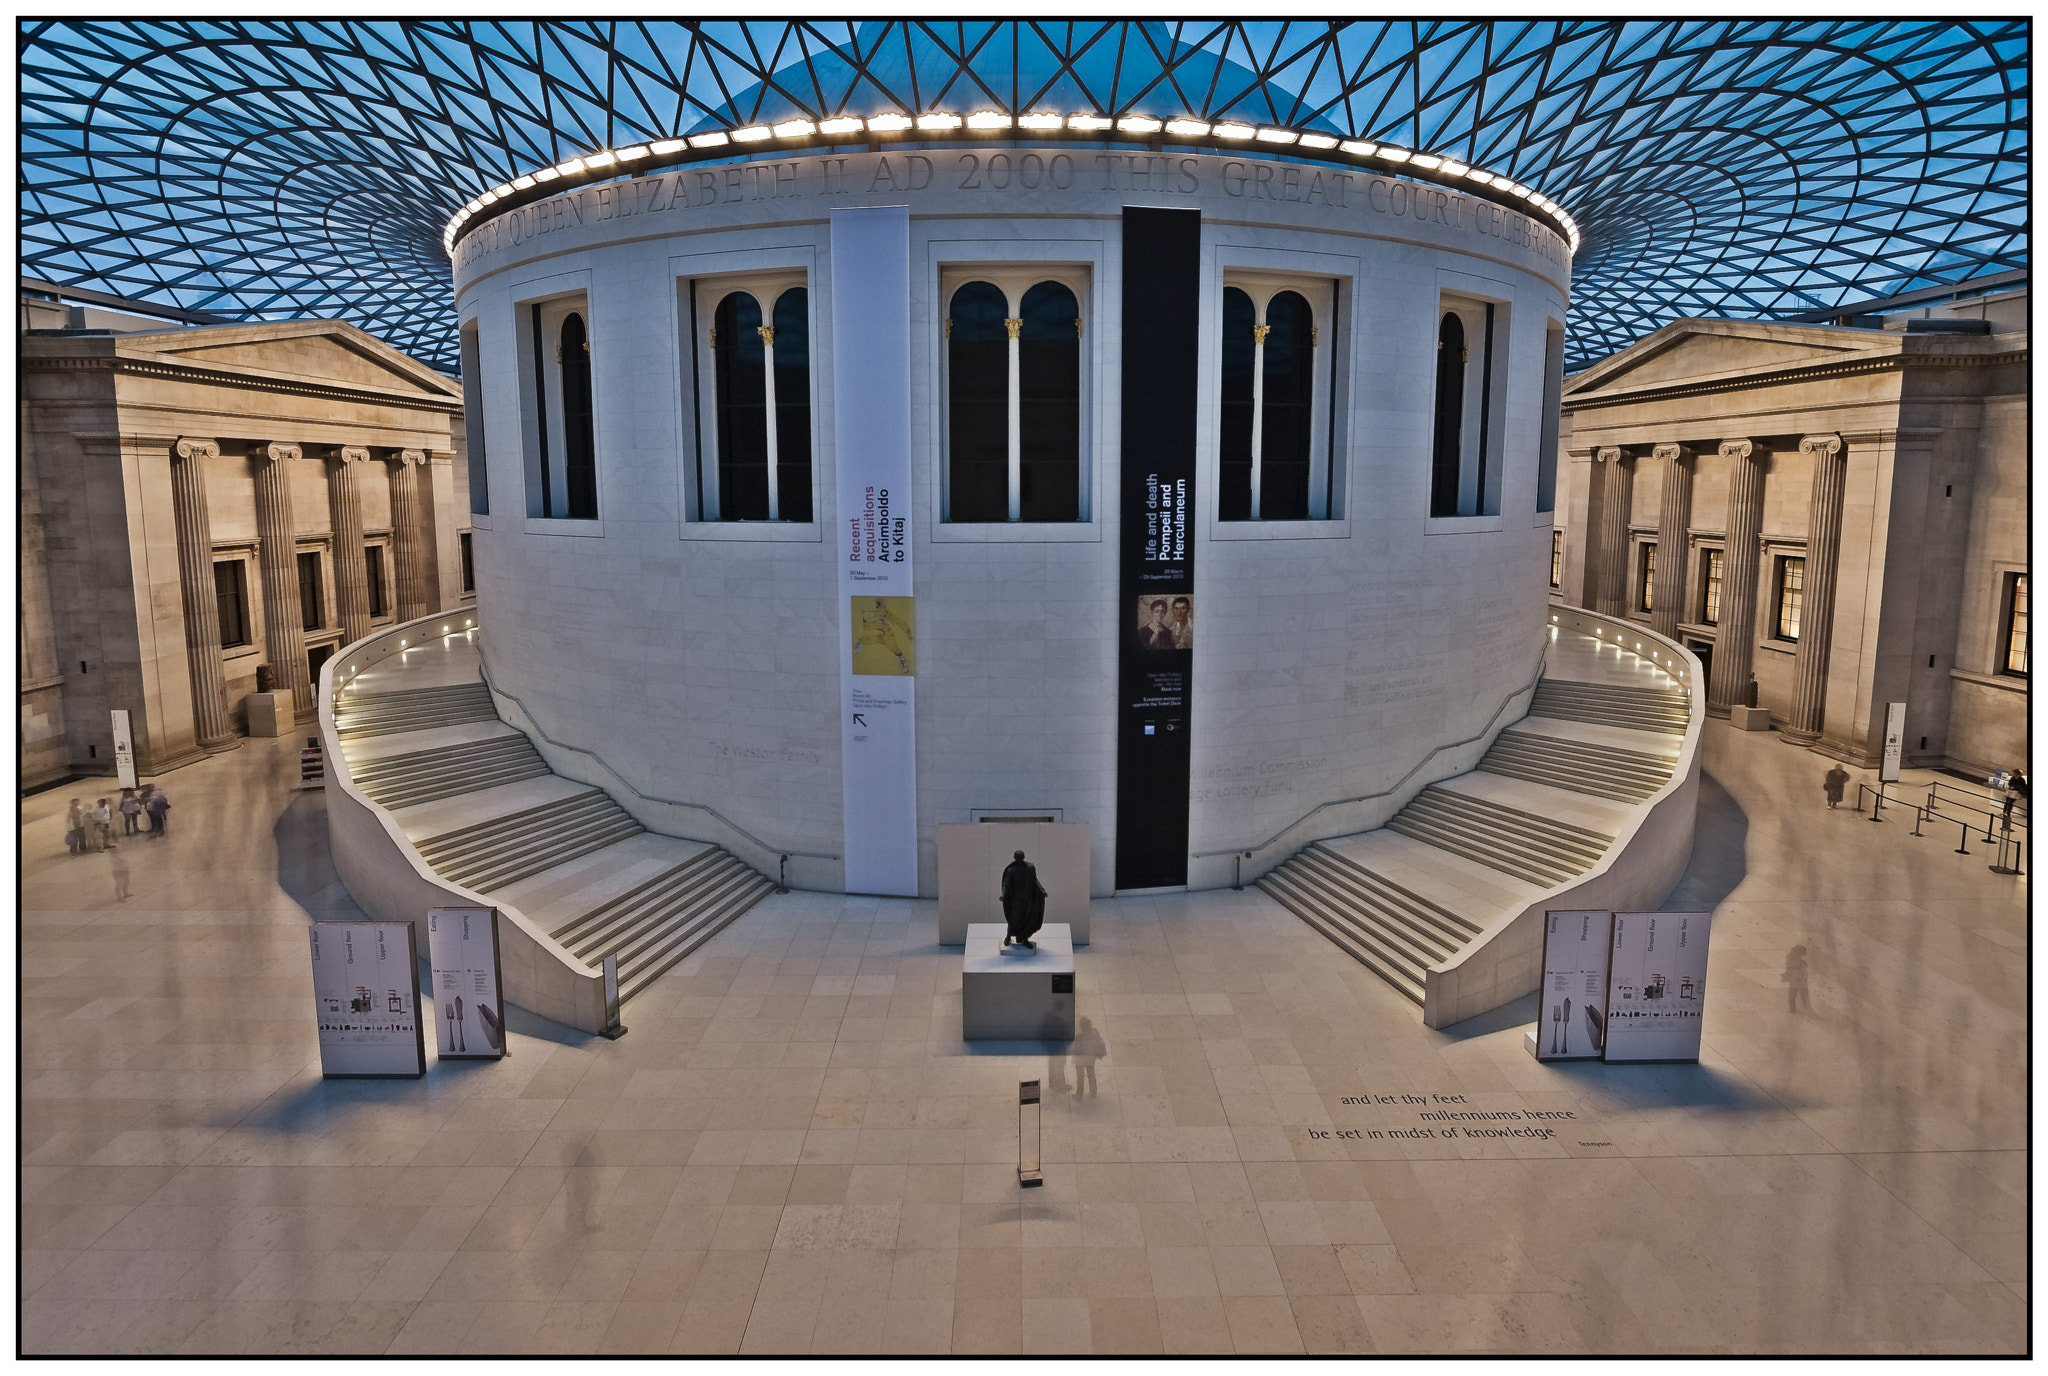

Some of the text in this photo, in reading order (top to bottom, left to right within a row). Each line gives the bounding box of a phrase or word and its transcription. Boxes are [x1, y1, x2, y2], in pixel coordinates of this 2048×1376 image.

[509, 193, 584, 247] QUEEN
[597, 162, 802, 222] ELIZABETH
[818, 158, 850, 195] II
[866, 155, 934, 192] AD
[958, 153, 1075, 190] 2000
[1095, 155, 1200, 194] THIS
[1222, 161, 1354, 209] GREAT
[1368, 179, 1466, 229] COURT
[849, 517, 861, 562] Recent
[863, 485, 877, 563] acquisitions
[877, 488, 890, 563] Arcimboldo
[892, 517, 906, 563] to Kitaj
[1145, 473, 1158, 561] Life and death
[1159, 484, 1173, 561] Pompeii and
[1173, 478, 1186, 561] Herculaneum
[1308, 1125, 1558, 1140] be set in midst of knowledge
[1340, 1092, 1468, 1107] and let thy feet
[1419, 1107, 1578, 1122] millenniums hence
